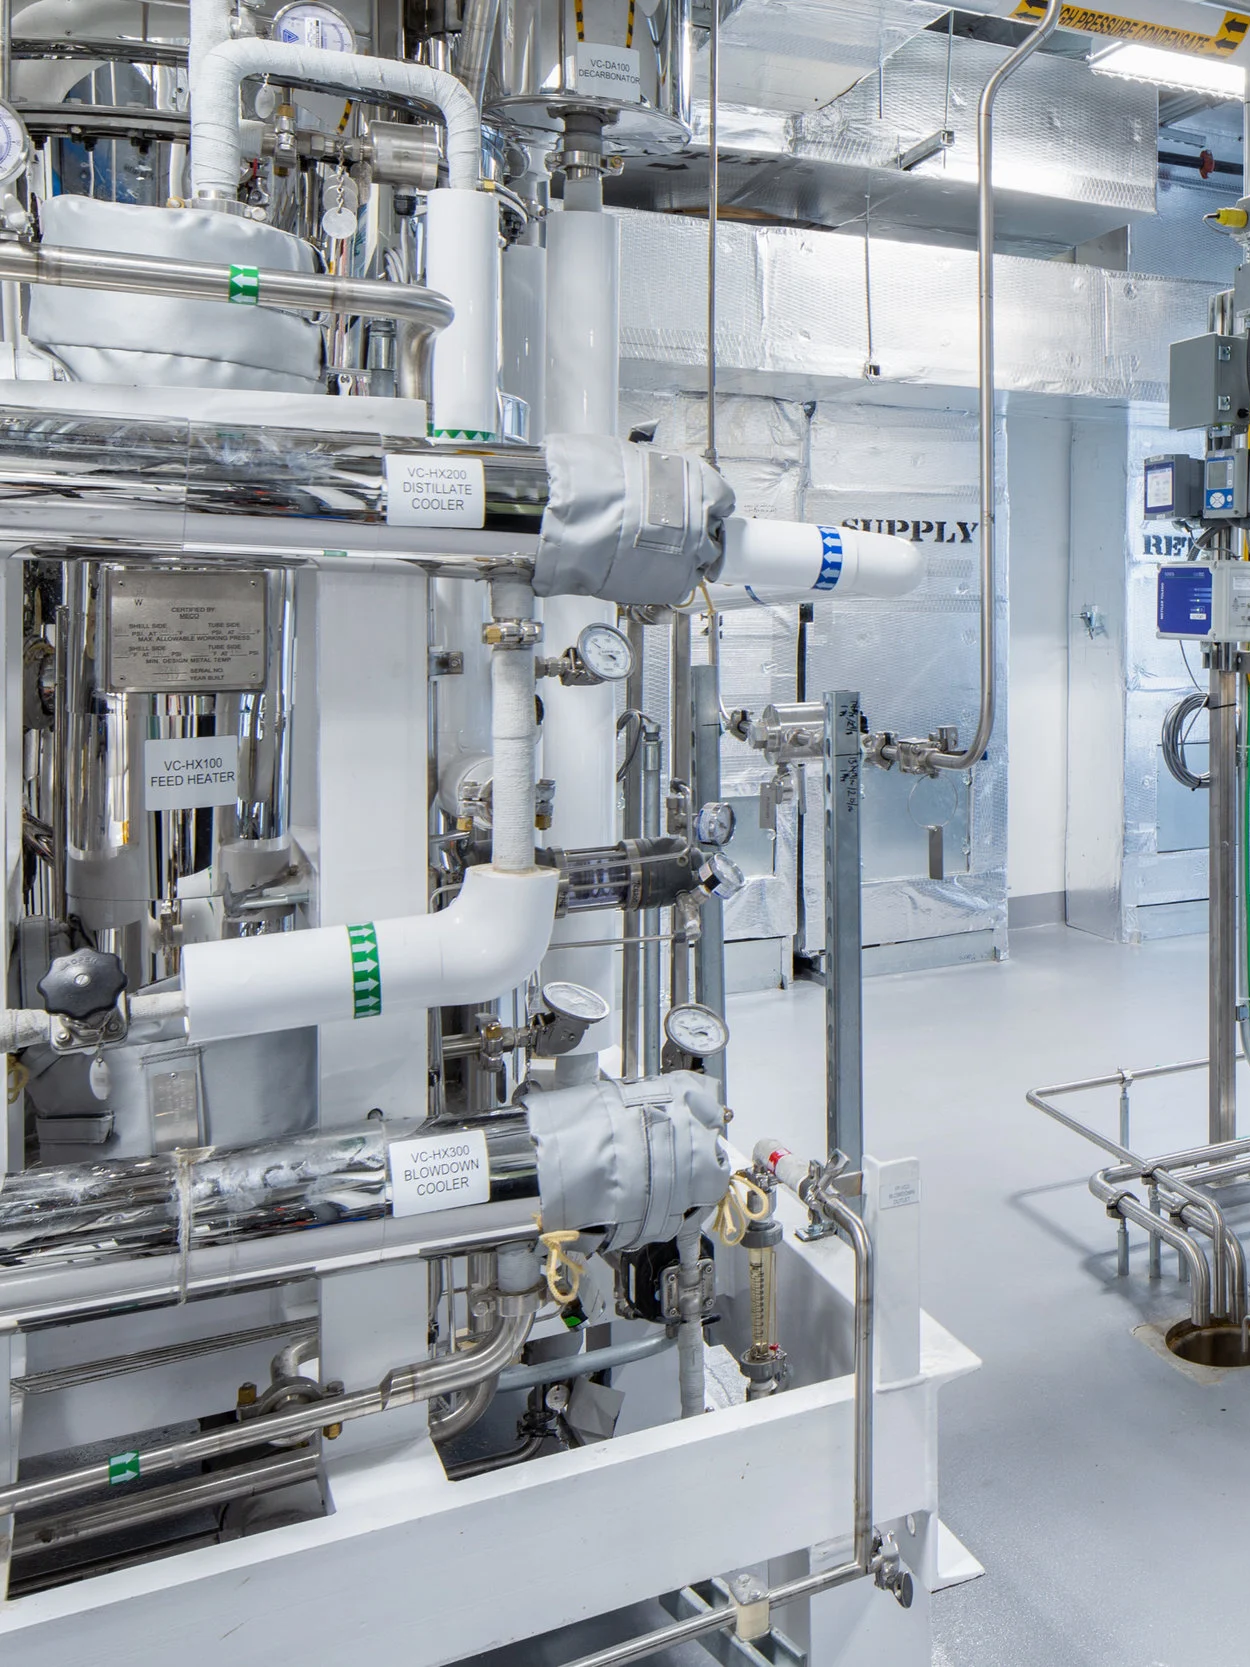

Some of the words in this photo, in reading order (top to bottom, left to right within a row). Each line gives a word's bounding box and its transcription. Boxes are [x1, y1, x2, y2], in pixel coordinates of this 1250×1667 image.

[1073, 11, 1139, 38] PRESSURE
[1133, 25, 1210, 54] CONDENSATE
[590, 59, 630, 72] VC-DA100
[578, 69, 640, 84] DECARBONATOR
[407, 467, 467, 480] VC-HX200
[403, 482, 472, 495] DISTILLATE
[411, 498, 464, 511] COOLER
[164, 757, 223, 771] VC-HX100
[151, 775, 184, 787] FEED
[187, 771, 235, 785] HEATER
[411, 1144, 470, 1163] VC-HX300
[404, 1158, 480, 1182] BLOWDOWN
[416, 1176, 469, 1196] COOLER
